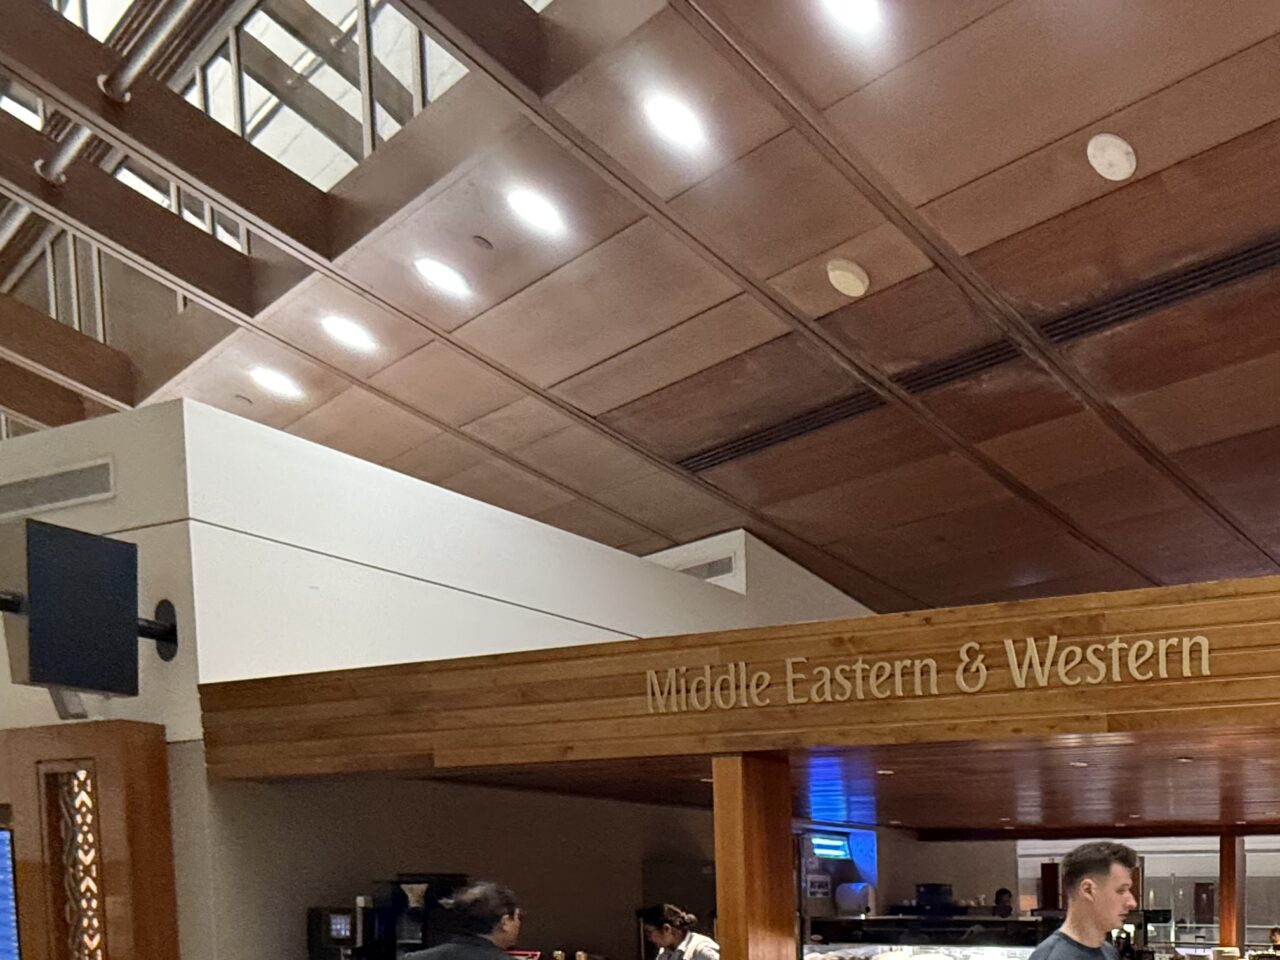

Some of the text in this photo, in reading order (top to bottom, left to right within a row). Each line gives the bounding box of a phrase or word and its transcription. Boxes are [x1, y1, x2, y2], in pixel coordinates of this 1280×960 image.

[646, 634, 1212, 713] Middle Eastern & Western
